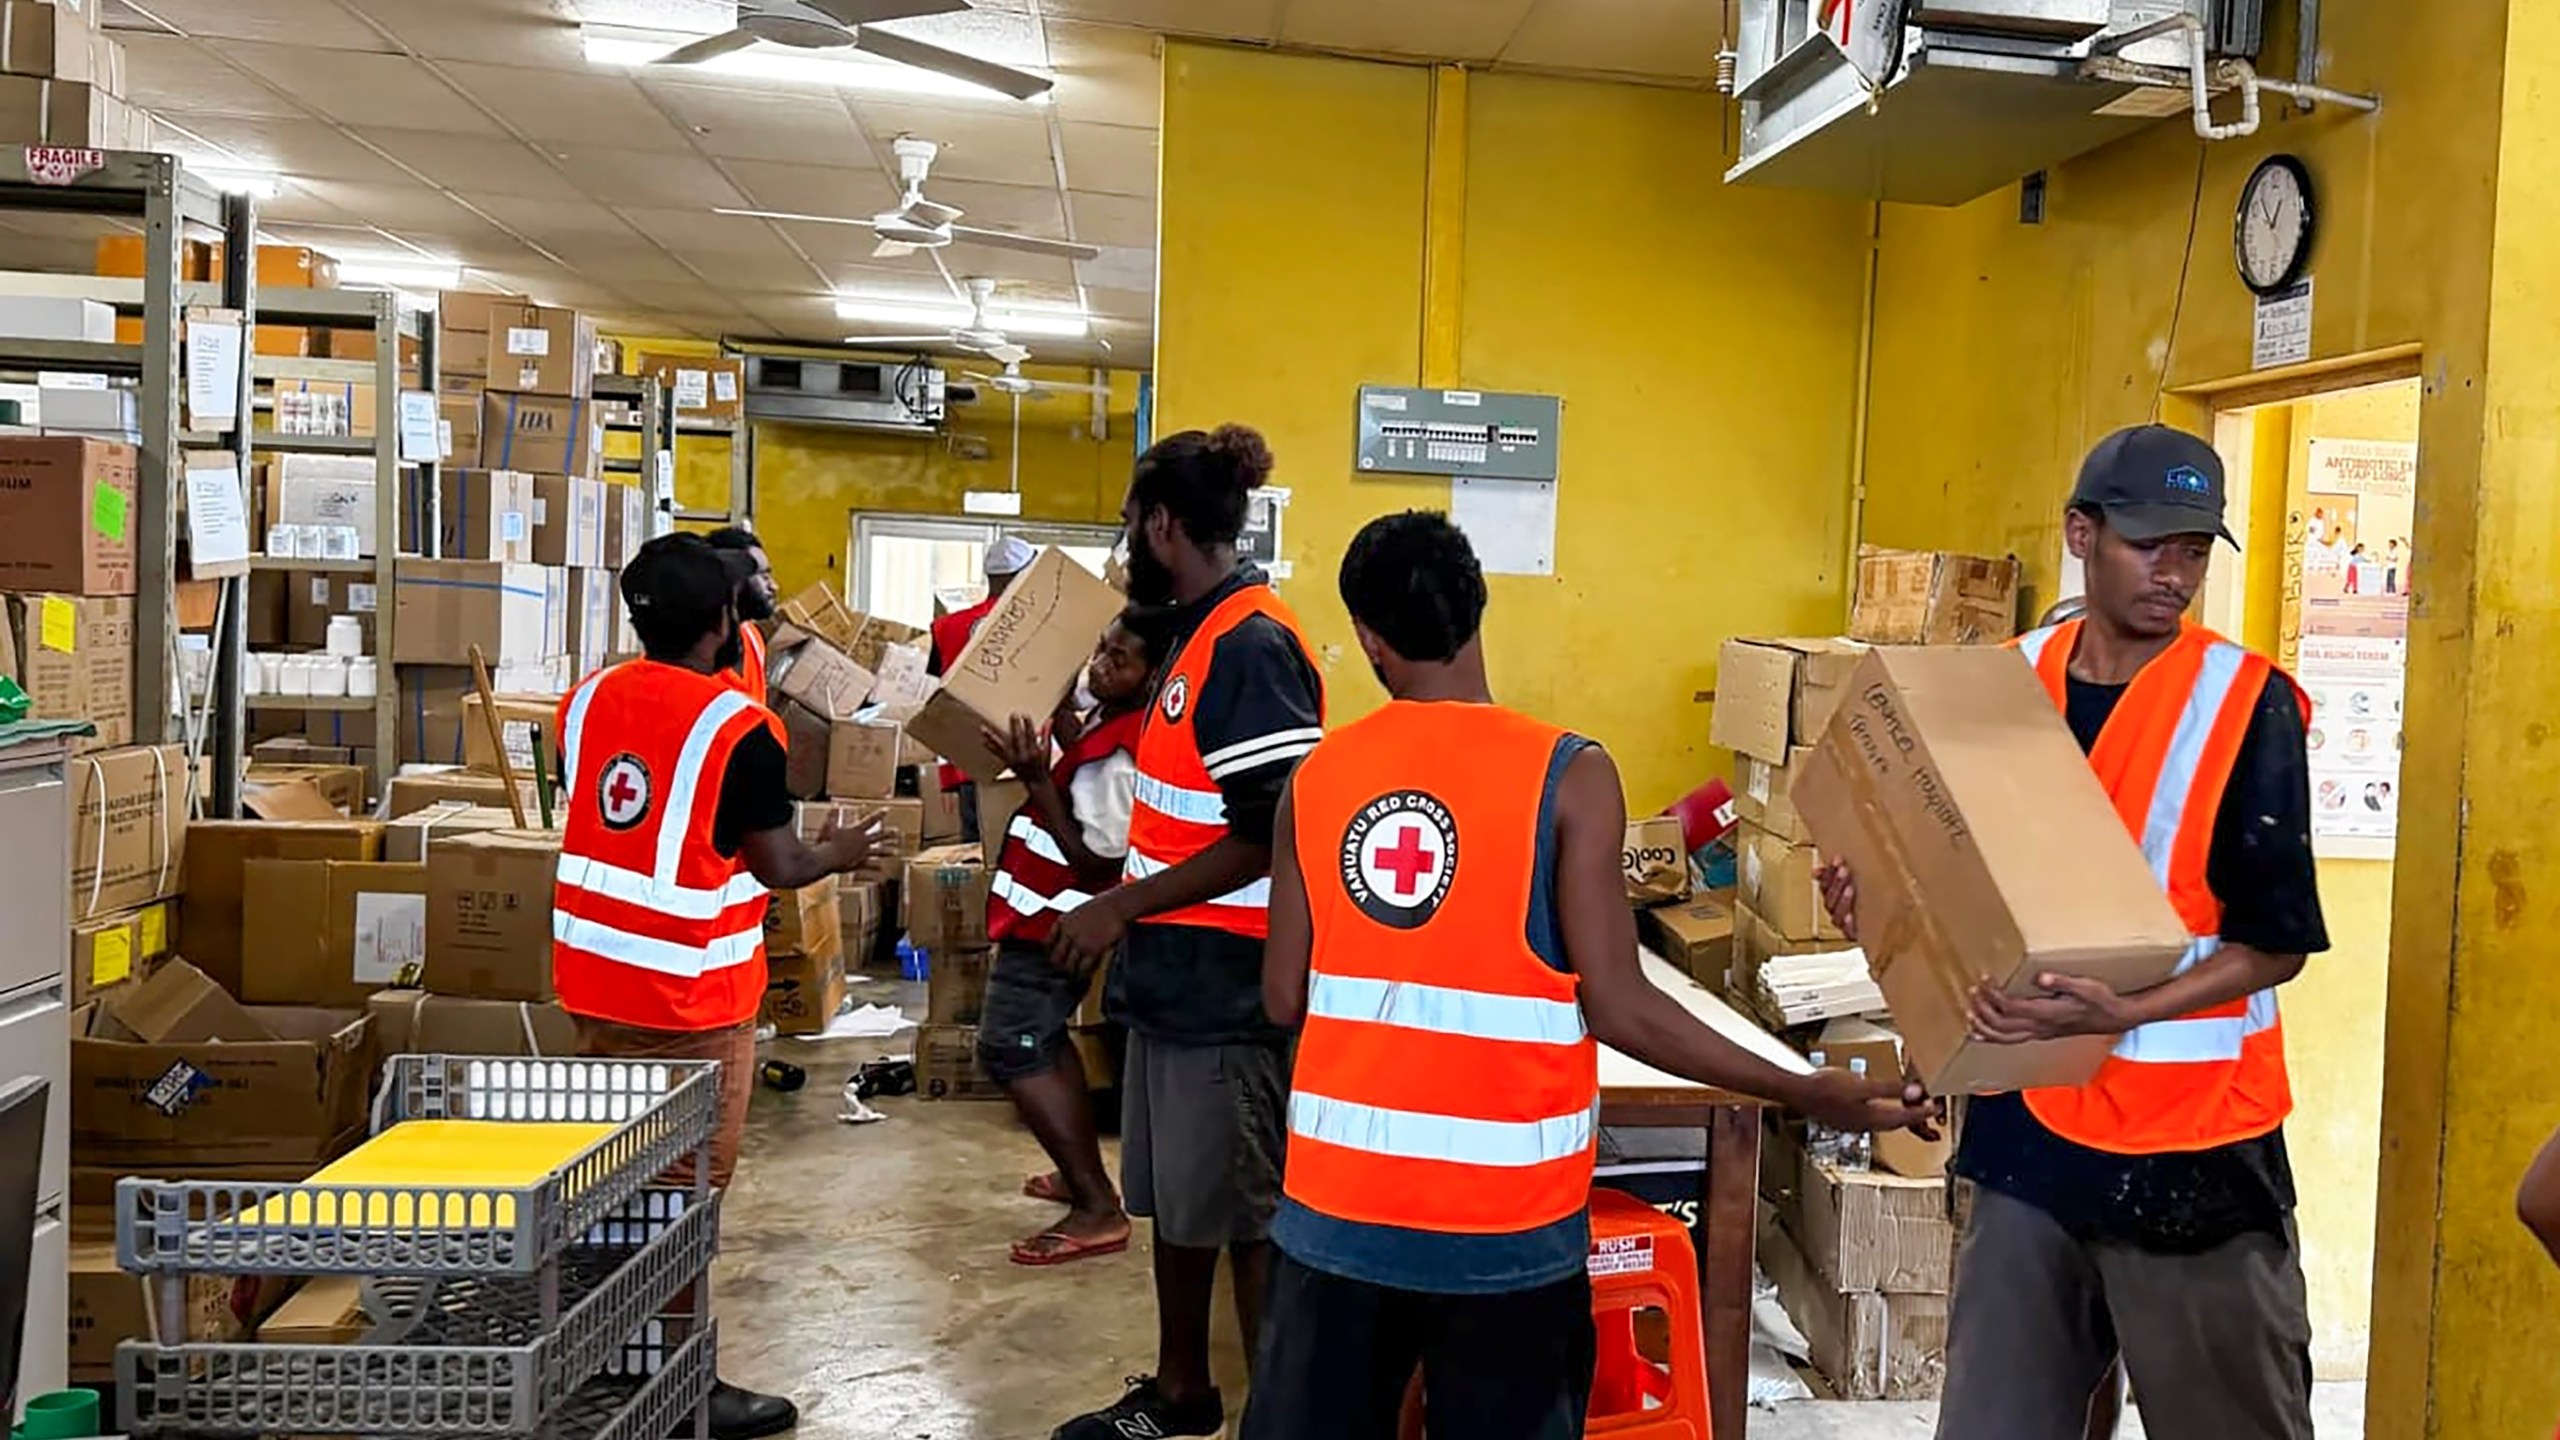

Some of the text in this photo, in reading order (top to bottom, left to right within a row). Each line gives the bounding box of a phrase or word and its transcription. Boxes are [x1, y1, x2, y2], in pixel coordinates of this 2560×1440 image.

[30, 150, 100, 165] FRAGILE
[1344, 795, 1456, 908] VANUATU RED CROSS SOCIETY
[1599, 1238, 1635, 1254] RUSH
